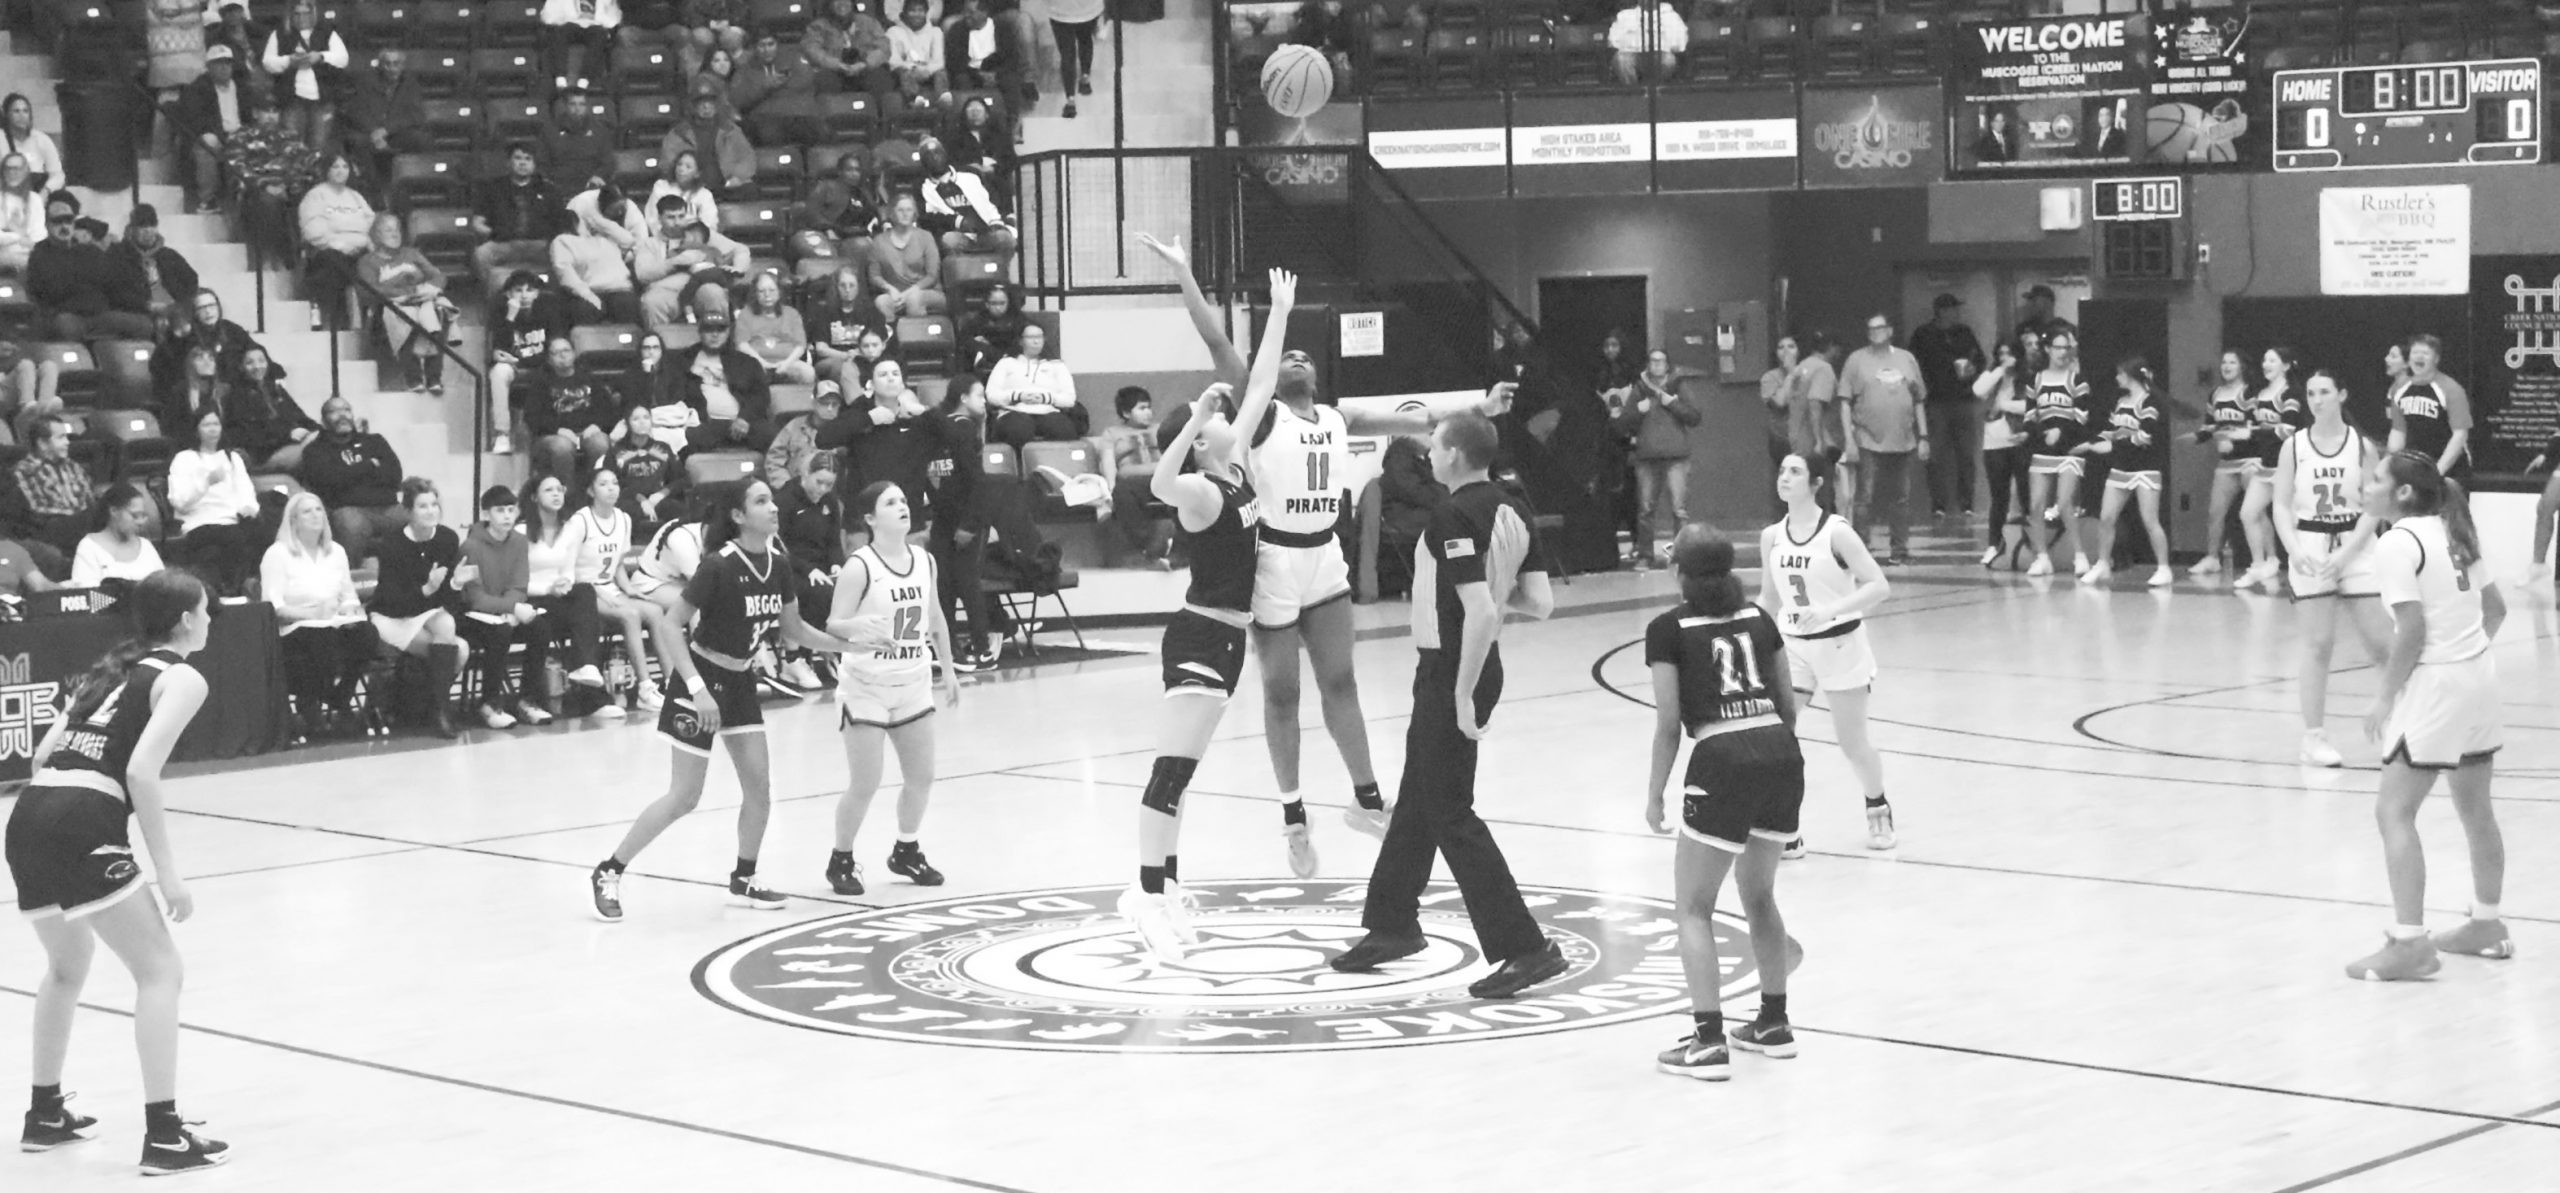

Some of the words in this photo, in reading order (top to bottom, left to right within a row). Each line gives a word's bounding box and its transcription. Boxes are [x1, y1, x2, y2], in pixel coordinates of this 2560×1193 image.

[1979, 20, 2125, 53] WELCOME
[2033, 54, 2047, 64] TO
[2050, 52, 2070, 63] THE
[2082, 61, 2123, 73] NATION
[2019, 74, 2085, 87] RESERVATION
[2282, 79, 2332, 101] HOME
[2374, 69, 2459, 108] 8:00
[2470, 69, 2537, 93] VISITOR
[2306, 107, 2330, 147] 0
[2507, 98, 2531, 139] 0
[1599, 132, 1622, 143] AREA
[1815, 121, 1859, 152] ONE
[1887, 120, 1931, 150] FIRE
[1532, 147, 1573, 158] MONTHLY
[1834, 150, 1912, 170] CASINO
[2117, 183, 2175, 212] 8:00
[2361, 193, 2436, 211] Rustler's
[2400, 213, 2435, 229] BBQ
[1300, 431, 1332, 445] LADY
[1307, 452, 1330, 491] 11
[2314, 467, 2345, 479] LADY
[1286, 497, 1339, 514] PIRATE
[598, 543, 617, 554] LADY
[598, 557, 612, 579] 2
[1780, 555, 1811, 569] LADY
[890, 586, 922, 602] LADY
[1789, 574, 1810, 607] 3
[894, 605, 922, 641] 12
[1711, 631, 1768, 696] 21
[815, 896, 1096, 943] DOME
